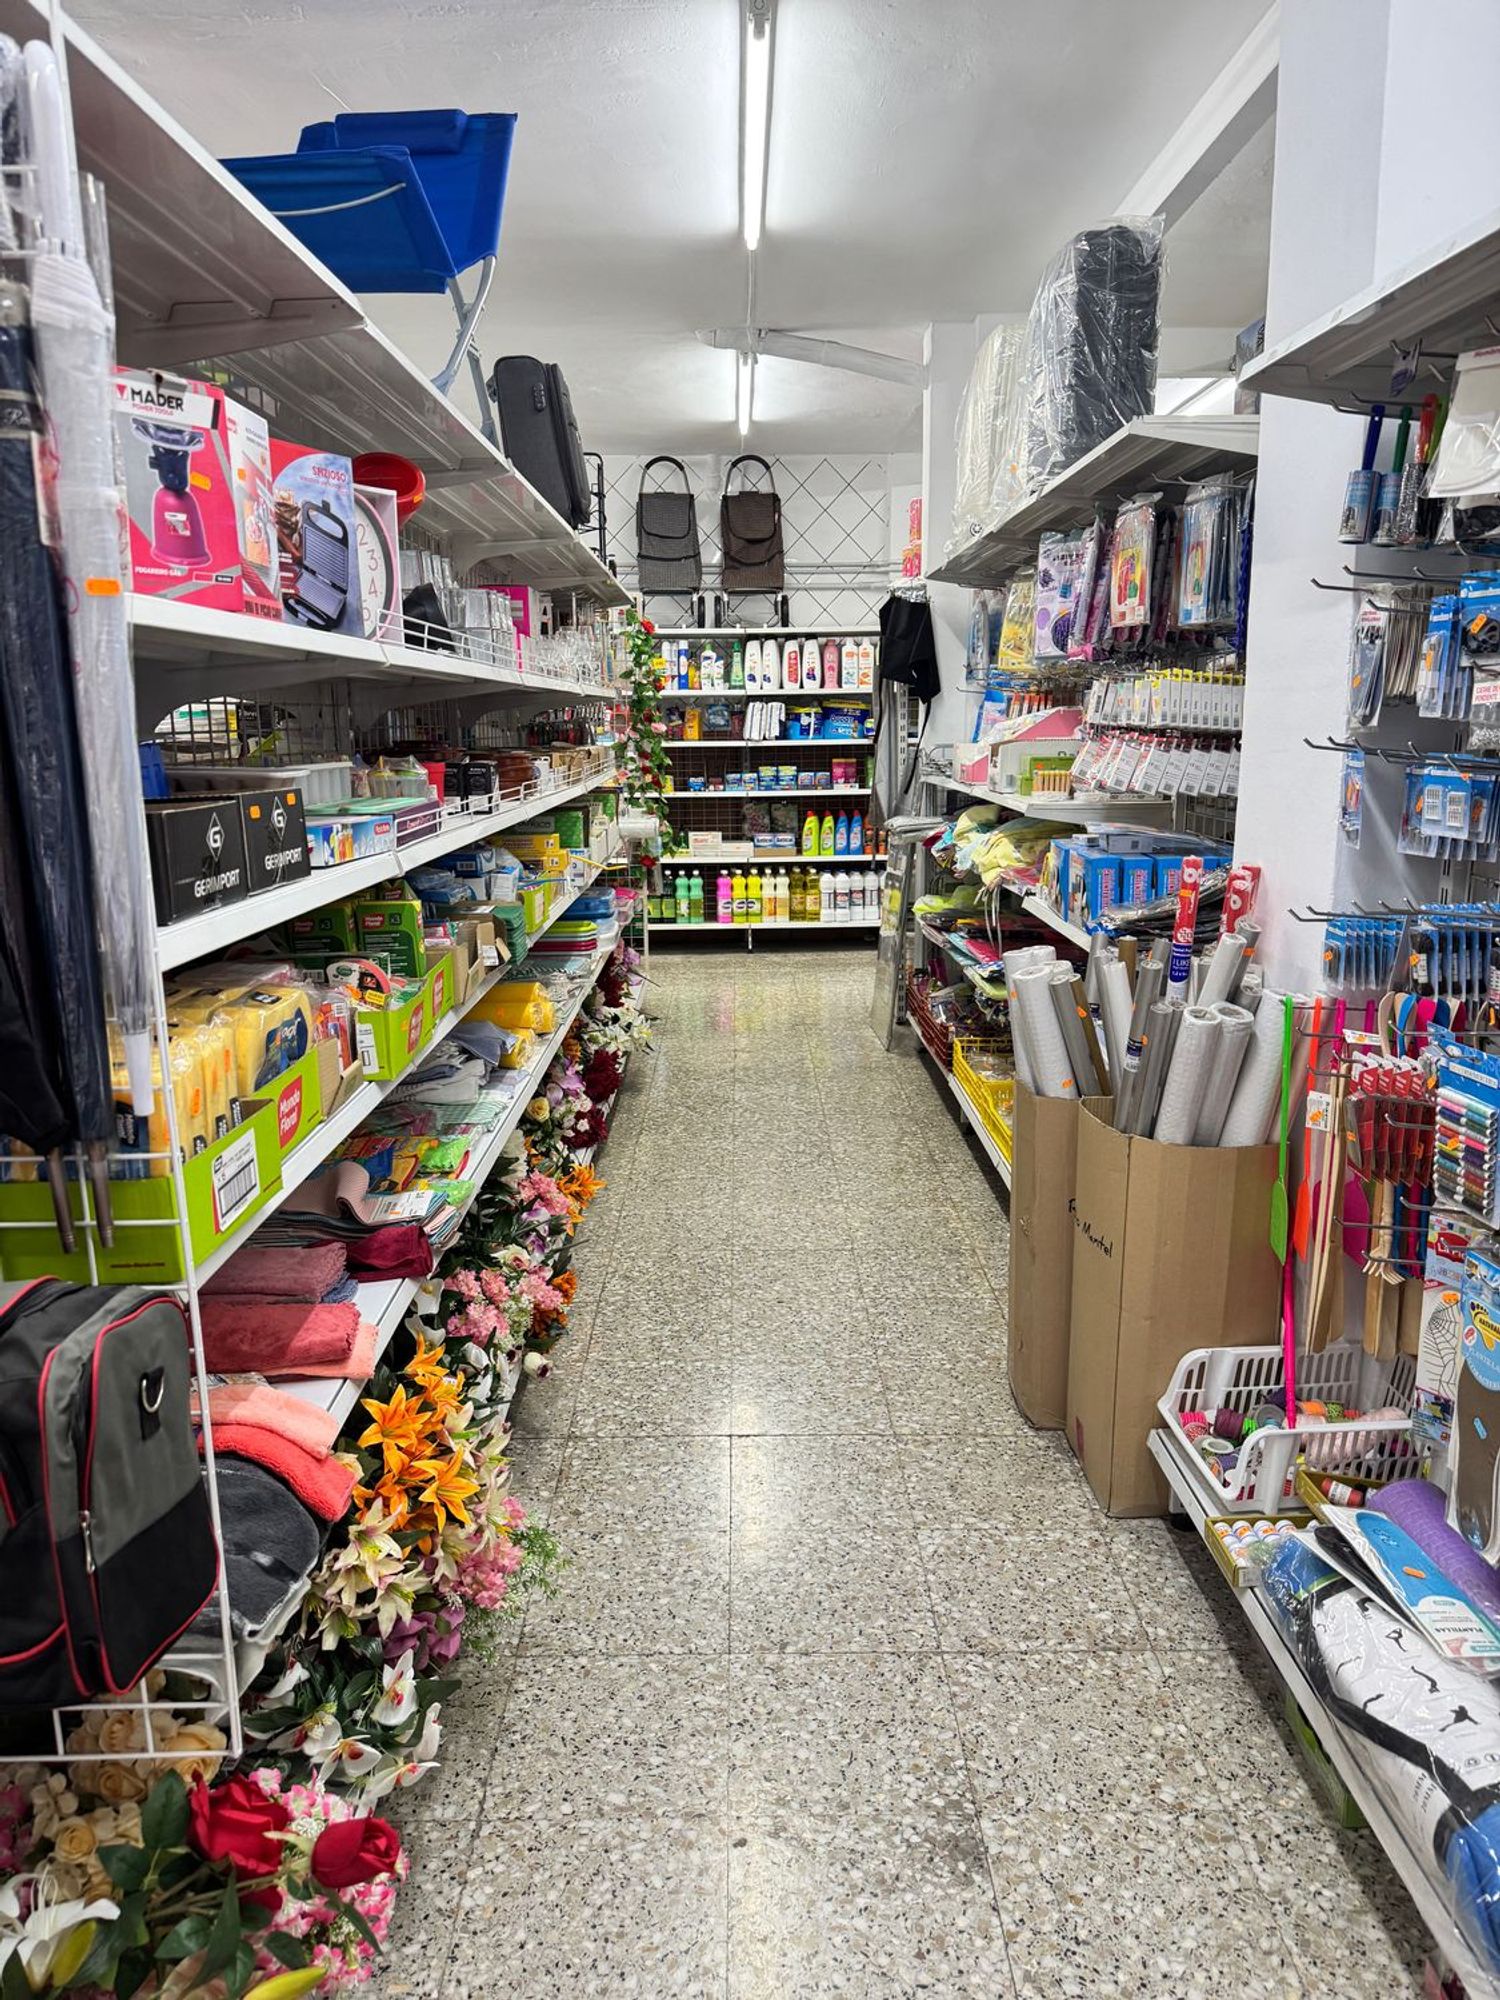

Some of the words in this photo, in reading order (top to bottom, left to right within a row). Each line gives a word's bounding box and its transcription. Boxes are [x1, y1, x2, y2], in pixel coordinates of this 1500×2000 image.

[131, 387, 184, 411] MADER
[367, 550, 379, 571] 3
[369, 576, 379, 597] 4
[274, 809, 284, 828] G
[209, 826, 221, 848] G
[265, 847, 303, 871] GERIMPORT
[194, 868, 240, 898] GERIMPORT
